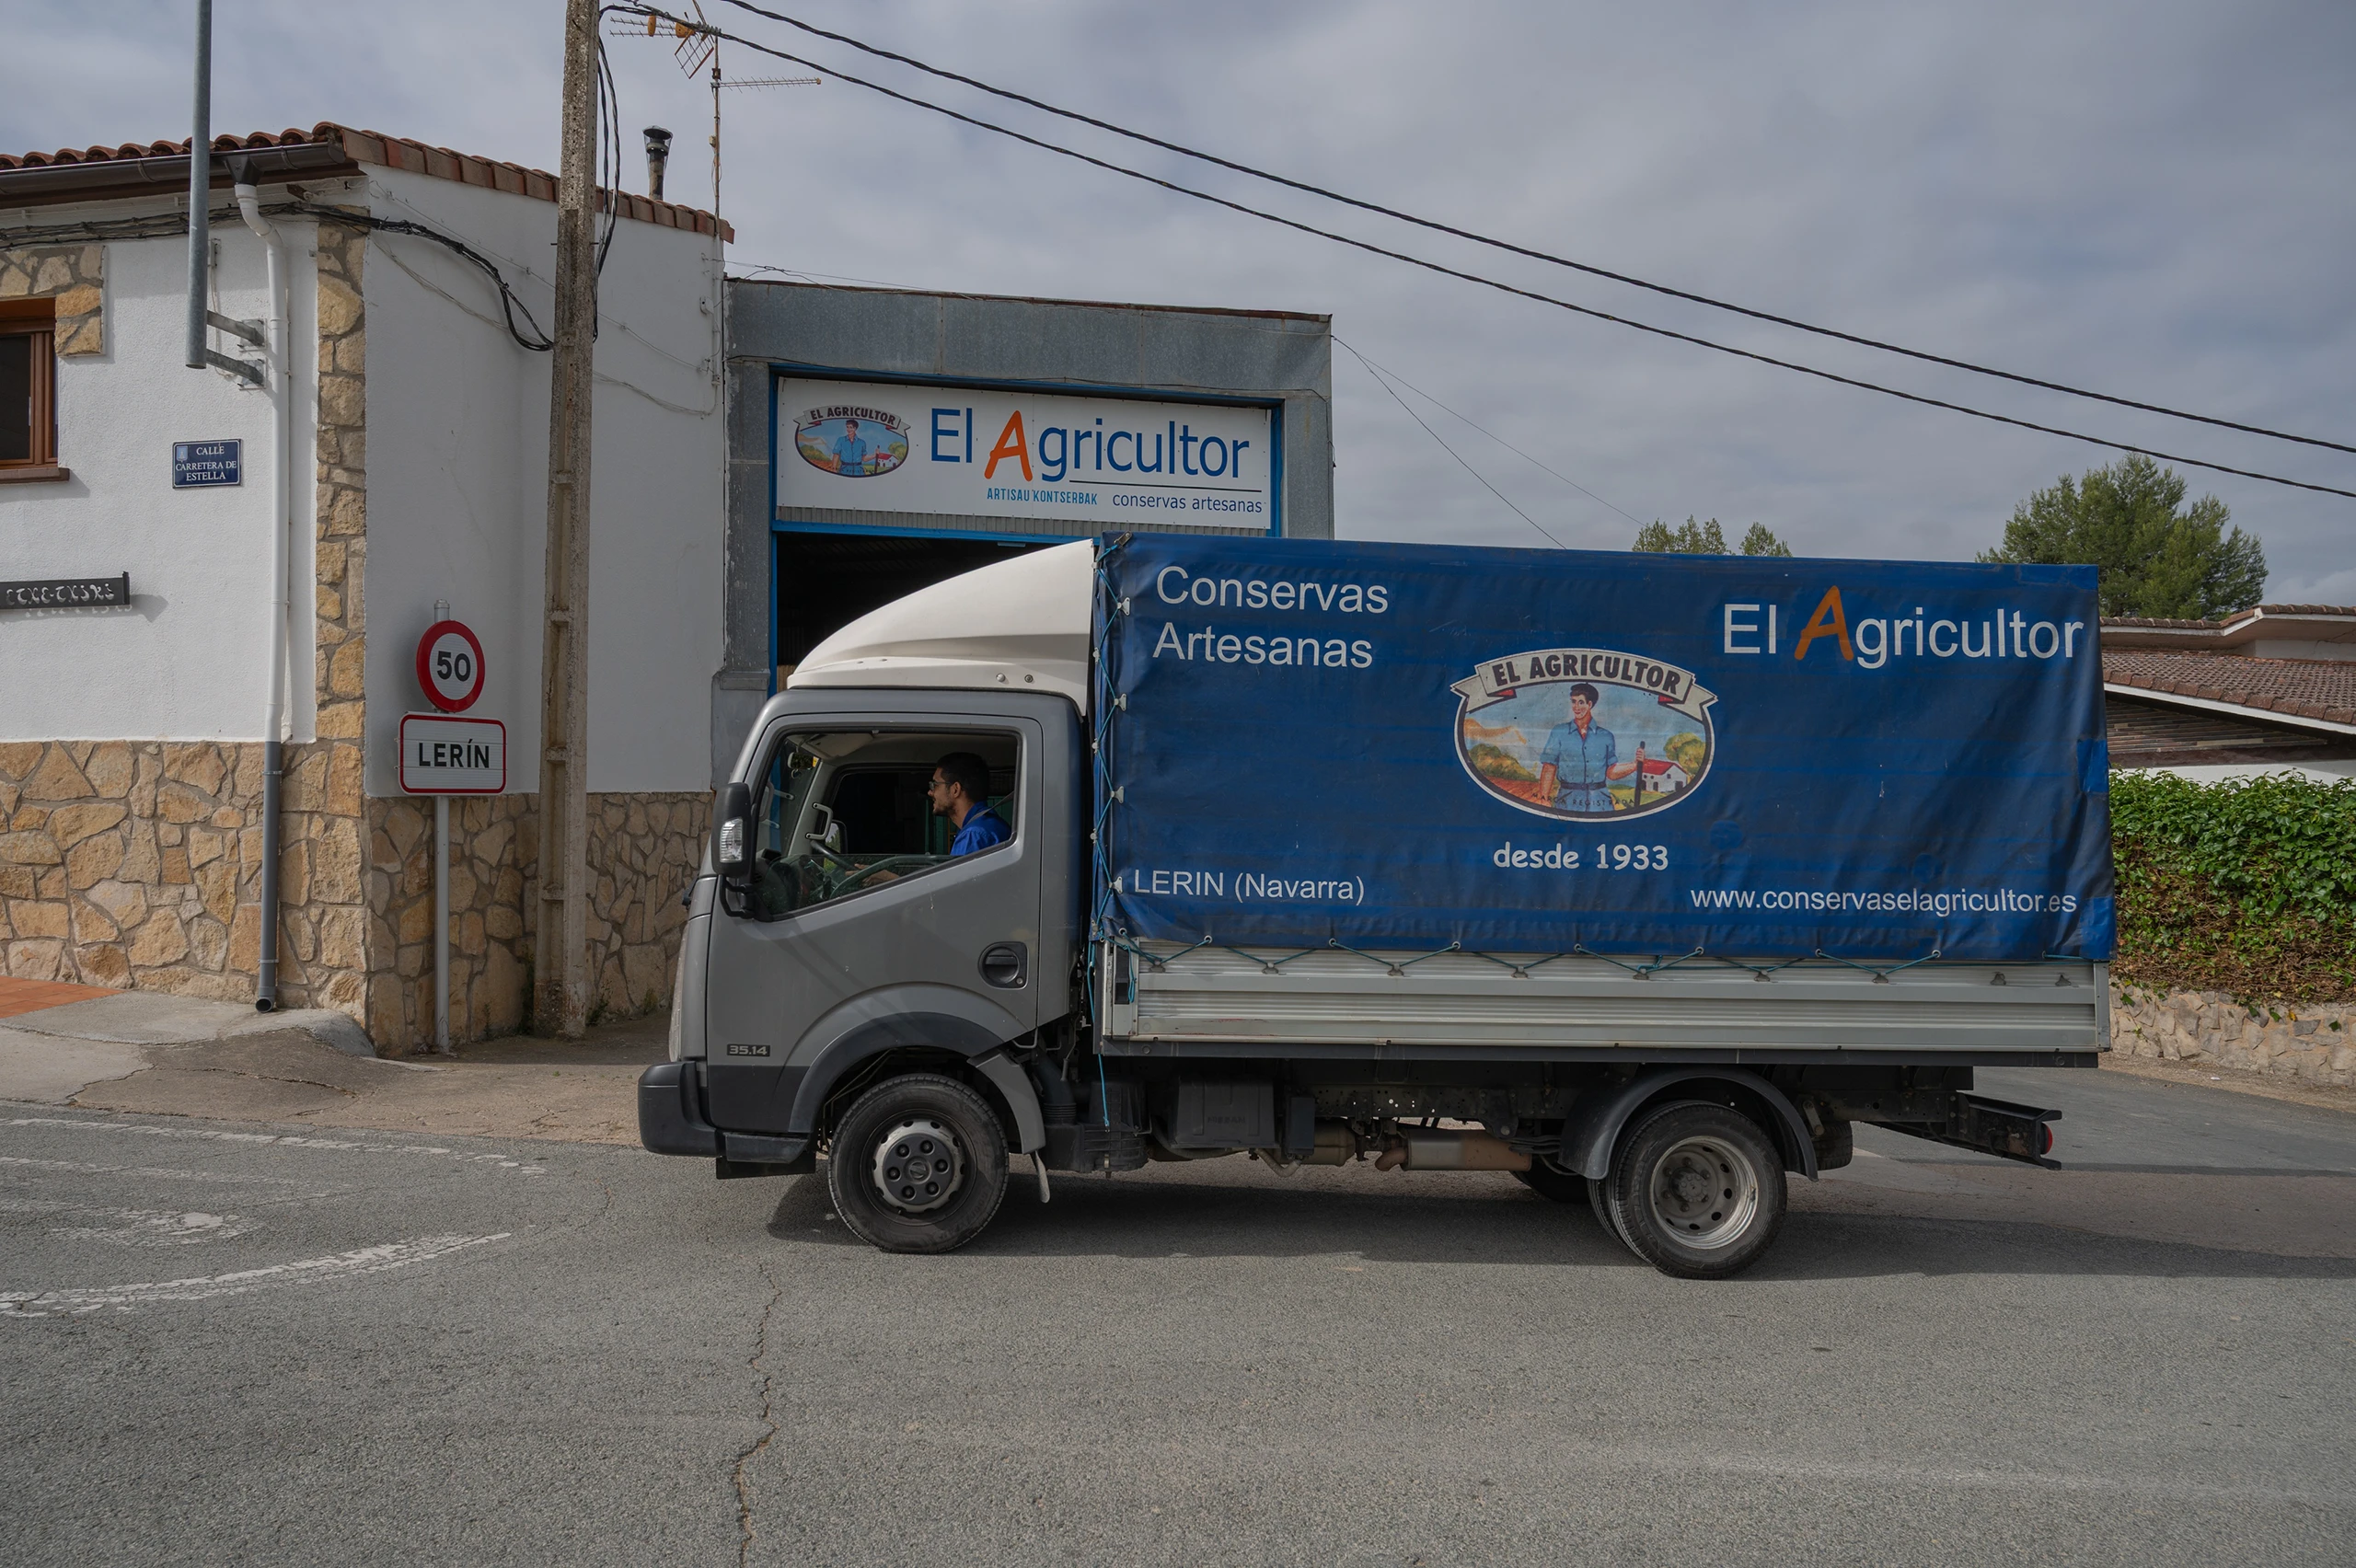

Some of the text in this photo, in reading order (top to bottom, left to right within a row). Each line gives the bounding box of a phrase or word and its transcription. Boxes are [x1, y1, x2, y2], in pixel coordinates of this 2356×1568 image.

[811, 406, 896, 426] EL AGRICULTOR
[196, 445, 225, 455] CALLE
[931, 408, 1250, 482] El Agricultor
[175, 460, 237, 471] CARRETERA DE
[186, 471, 226, 481] ESTELLA
[987, 488, 1098, 505] ARTISAU KONTSERBAK
[1112, 494, 1263, 513] conservas artesanas
[1156, 565, 1389, 614] Conservas
[1724, 584, 2084, 670] El Agricultor
[1152, 621, 1373, 669] Artesanas
[436, 650, 471, 683] 50
[1492, 653, 1681, 695] EL AGRICULTOR
[419, 738, 490, 768] LERÍN
[1531, 792, 1567, 805] MARCA
[1493, 841, 1669, 871] desde 1933
[1134, 869, 1365, 906] LERIN (Navarra)
[1690, 888, 2078, 918] www.conservaselagricultor.es
[729, 1044, 768, 1055] 35.14
